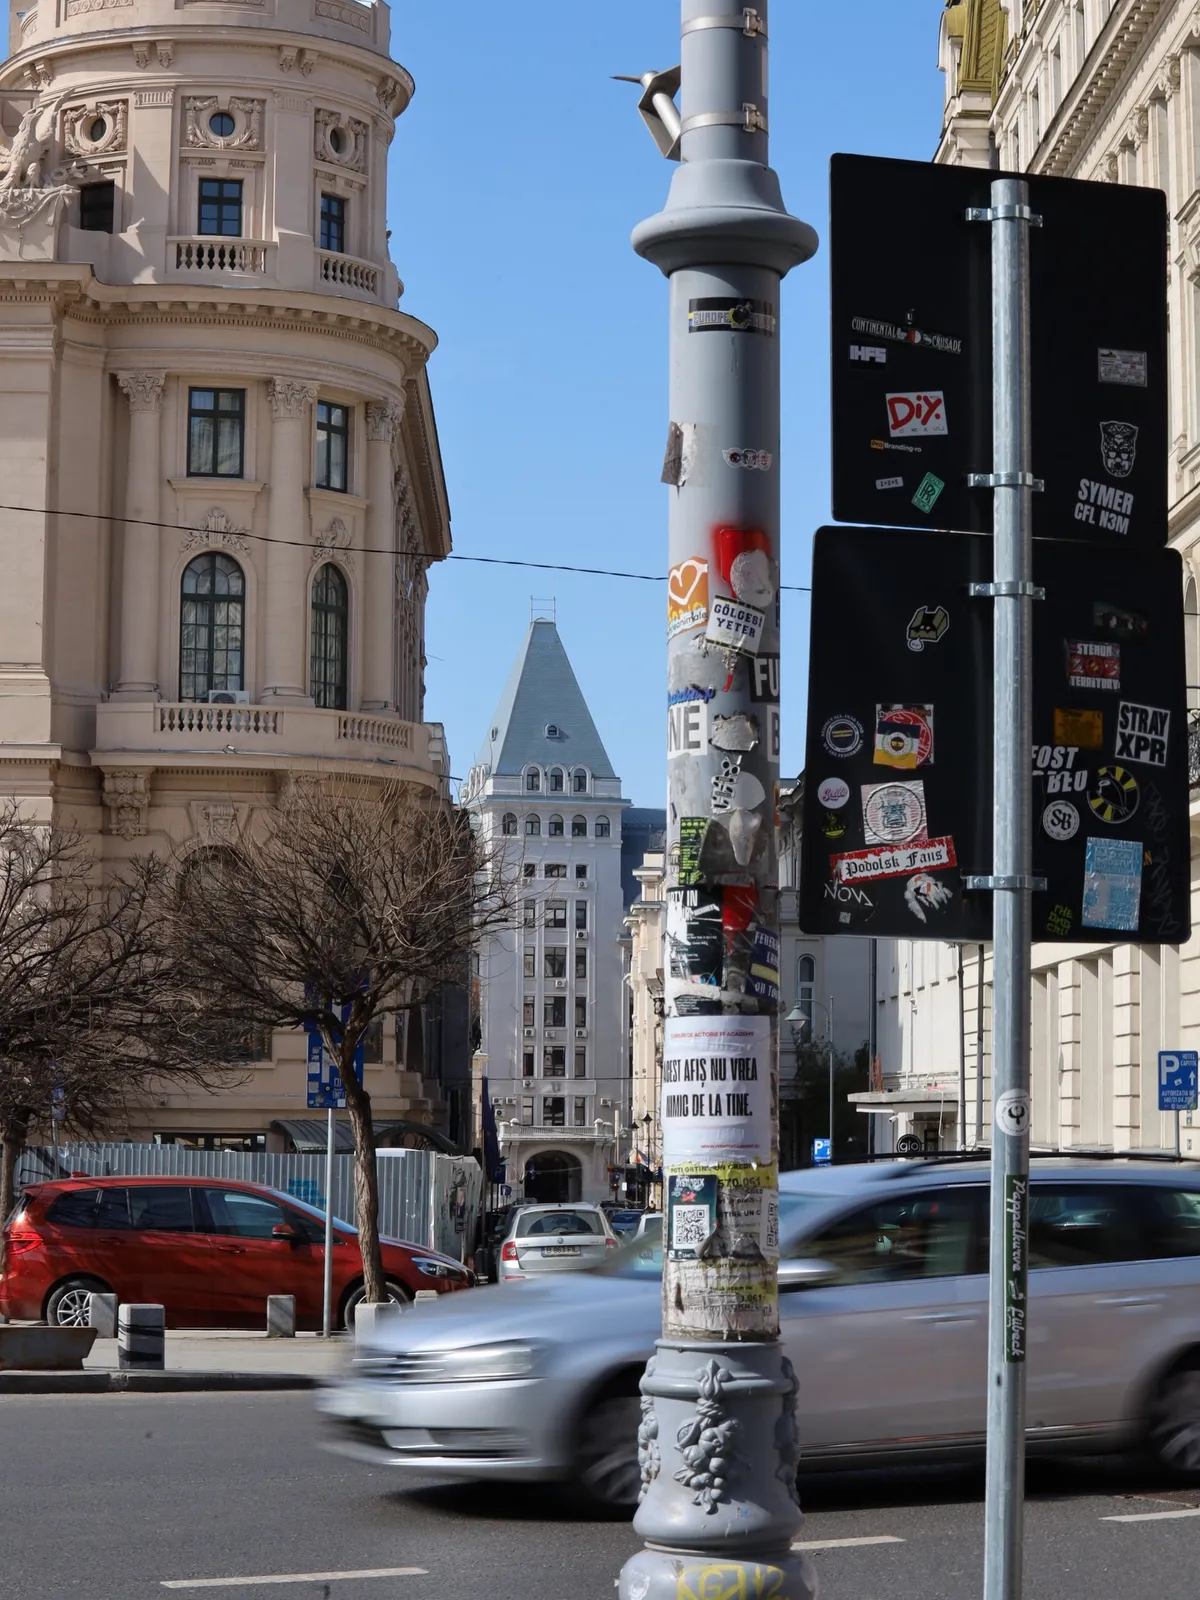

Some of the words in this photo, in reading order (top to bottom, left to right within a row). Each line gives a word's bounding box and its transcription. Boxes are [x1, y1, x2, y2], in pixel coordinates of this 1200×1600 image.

[851, 318, 897, 340] CONTINENTAL
[932, 336, 962, 353] CRUSADE
[1078, 478, 1134, 515] SYMER
[1074, 502, 1096, 525] CFL
[1099, 513, 1130, 535] N3M
[717, 617, 756, 638] YETER
[1120, 704, 1169, 737] STRAY
[1117, 732, 1165, 765] XPR
[845, 858, 900, 877] Podolsk
[905, 850, 943, 868] Fans
[710, 1058, 727, 1081] NU
[730, 1058, 758, 1081] VREA
[1161, 1055, 1179, 1085] P
[692, 1094, 705, 1117] DE
[708, 1093, 722, 1117] LA
[726, 1093, 753, 1117] TINE.
[814, 1141, 823, 1155] P
[900, 1142, 919, 1152] glo
[1007, 1179, 1025, 1272] Pappelkurve
[1010, 1307, 1025, 1356] Lübeck
